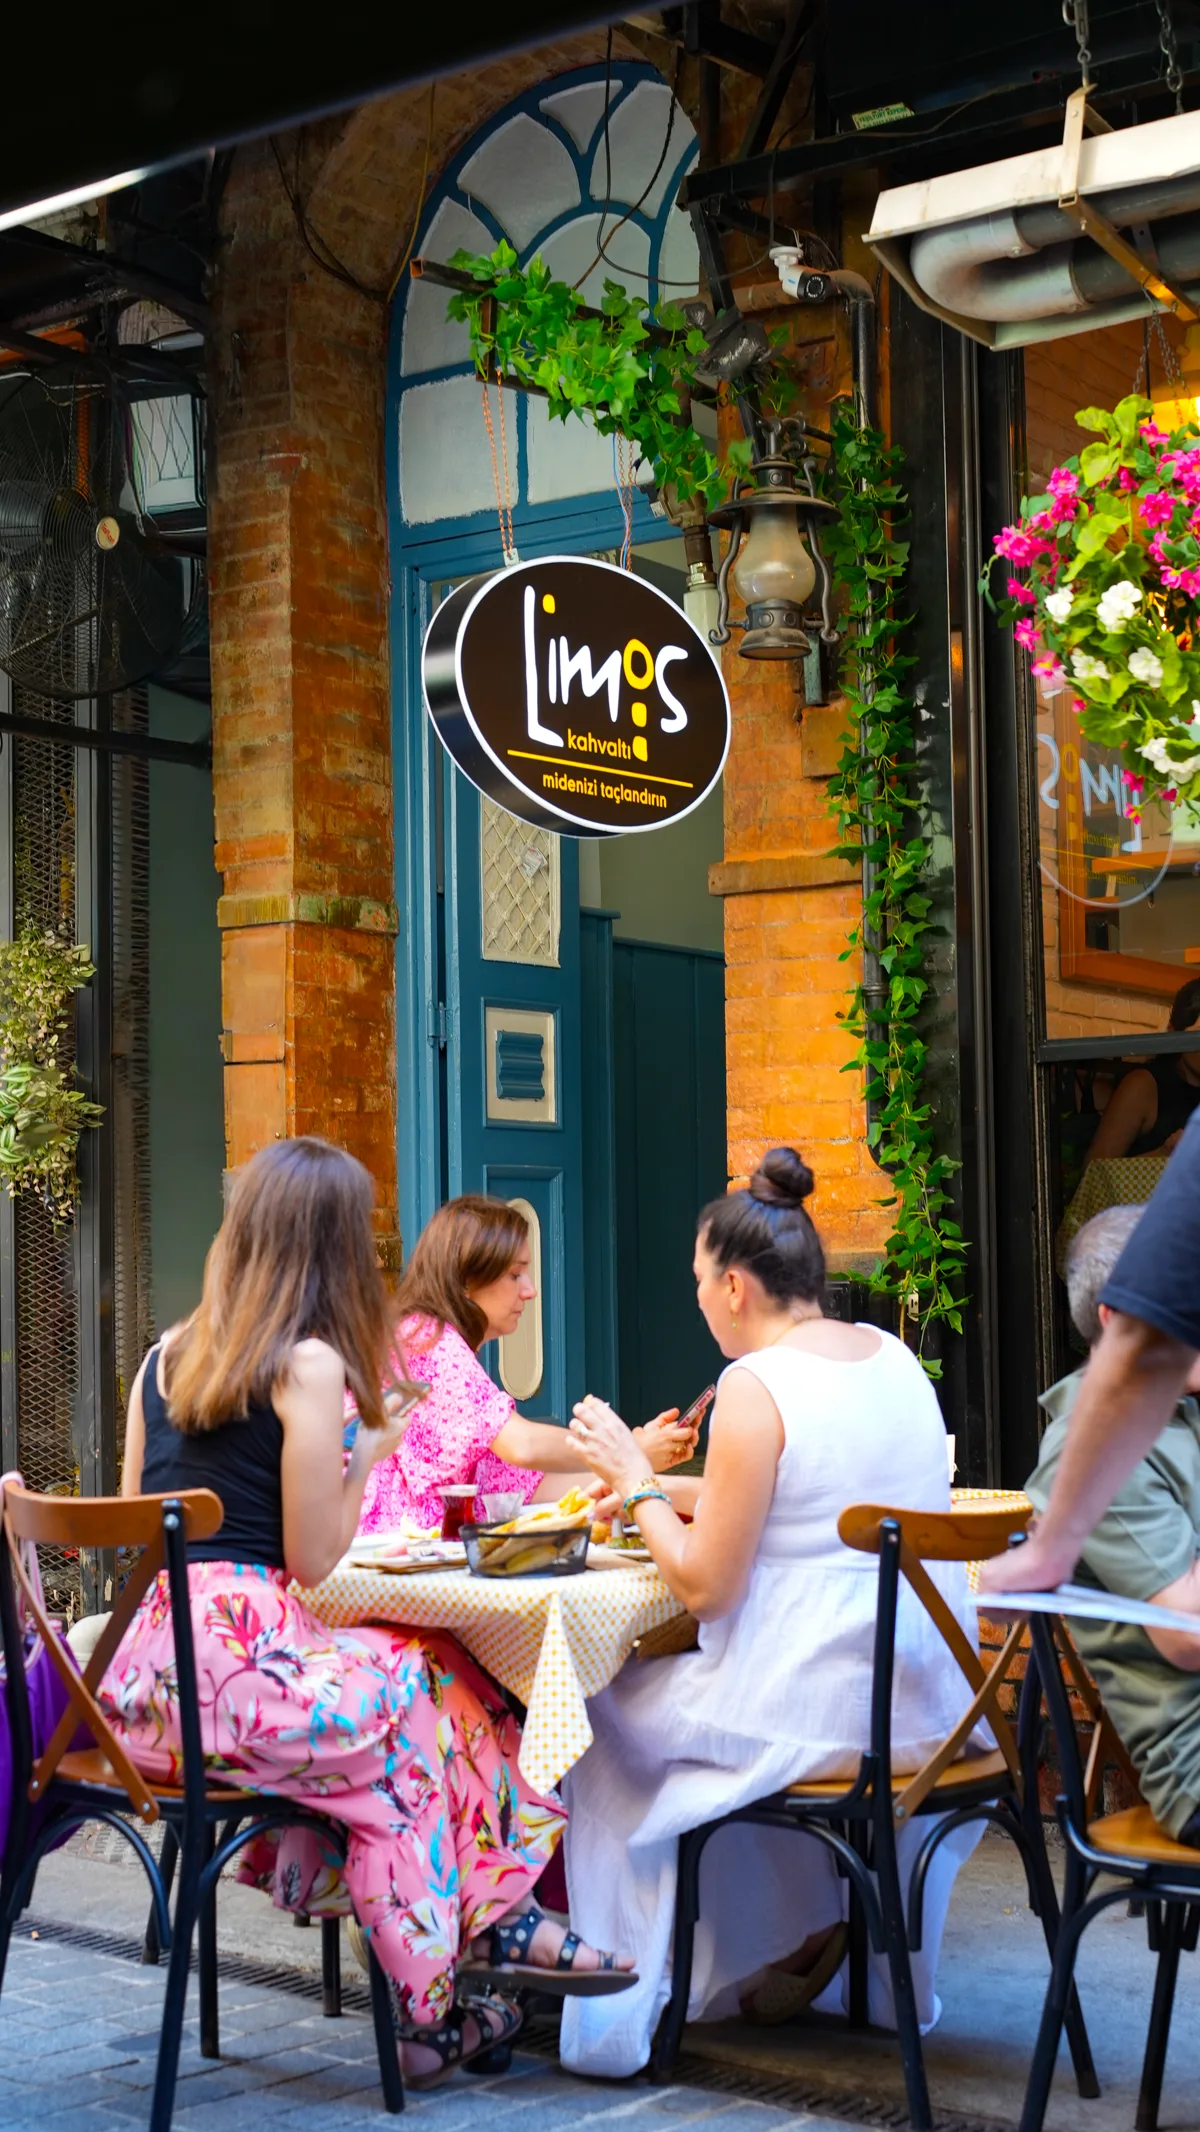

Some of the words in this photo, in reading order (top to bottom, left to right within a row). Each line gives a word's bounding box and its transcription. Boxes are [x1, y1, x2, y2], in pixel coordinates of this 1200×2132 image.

[567, 728, 631, 760] kahvaltı
[542, 771, 598, 796] midenizi
[600, 782, 667, 809] taçlandırın
